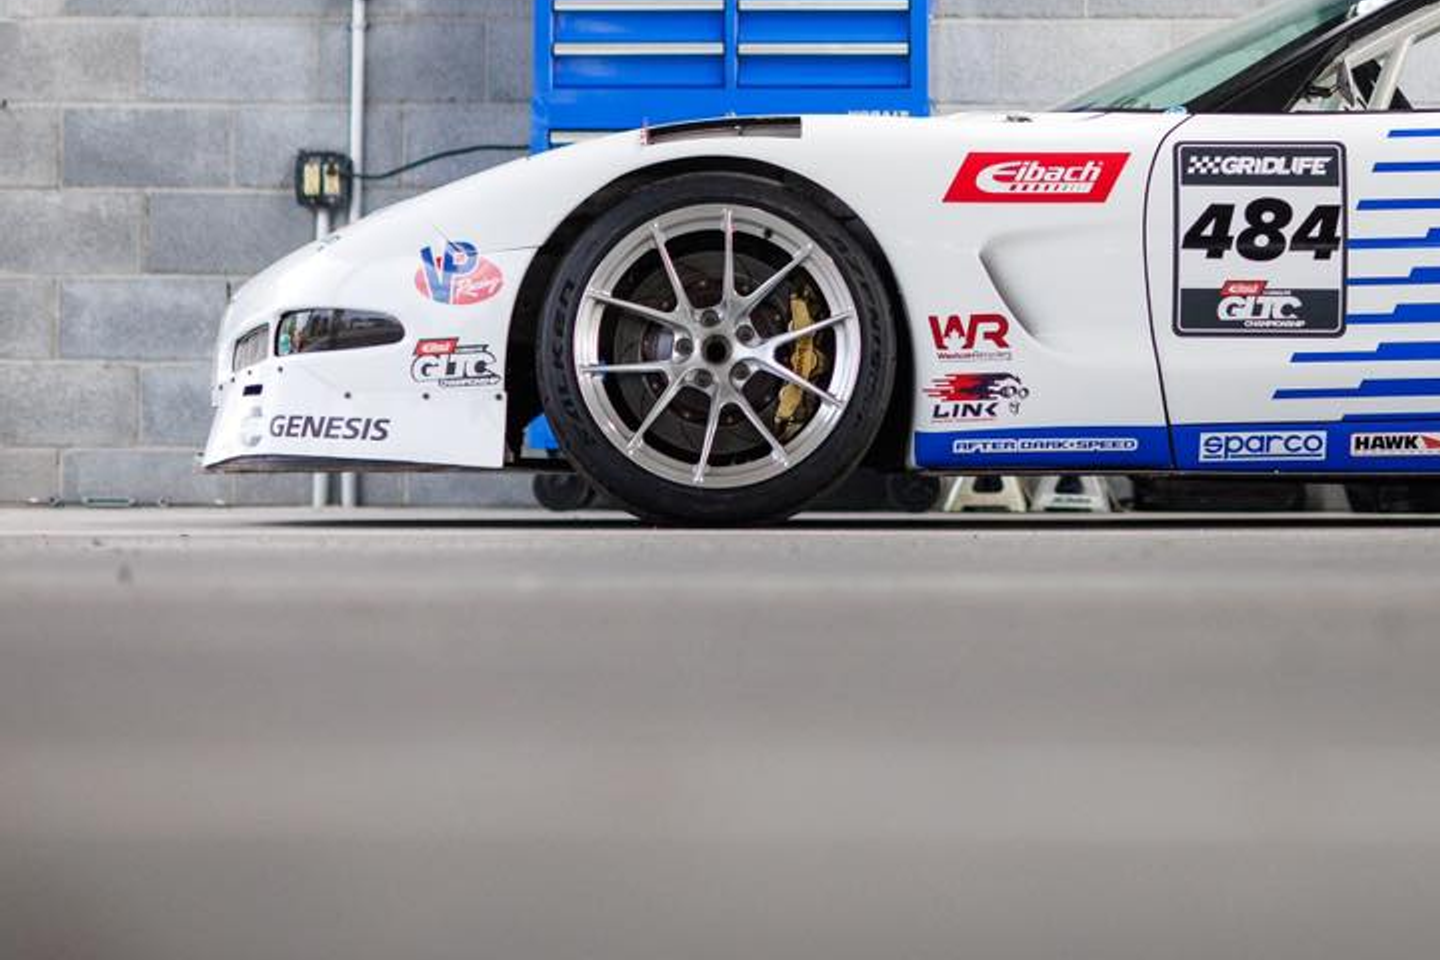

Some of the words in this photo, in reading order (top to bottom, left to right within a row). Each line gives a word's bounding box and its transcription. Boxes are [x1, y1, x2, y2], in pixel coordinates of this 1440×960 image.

[976, 159, 1103, 193] Eibach
[1220, 156, 1333, 176] GRIDLIFE
[1182, 197, 1343, 262] 484
[420, 240, 478, 303] VP
[1217, 295, 1302, 320] GLTC
[928, 314, 1010, 351] WR
[932, 402, 999, 418] LINK
[269, 414, 391, 441] GENESIS
[1203, 434, 1323, 459] sparco
[1355, 435, 1419, 450] HAWK
